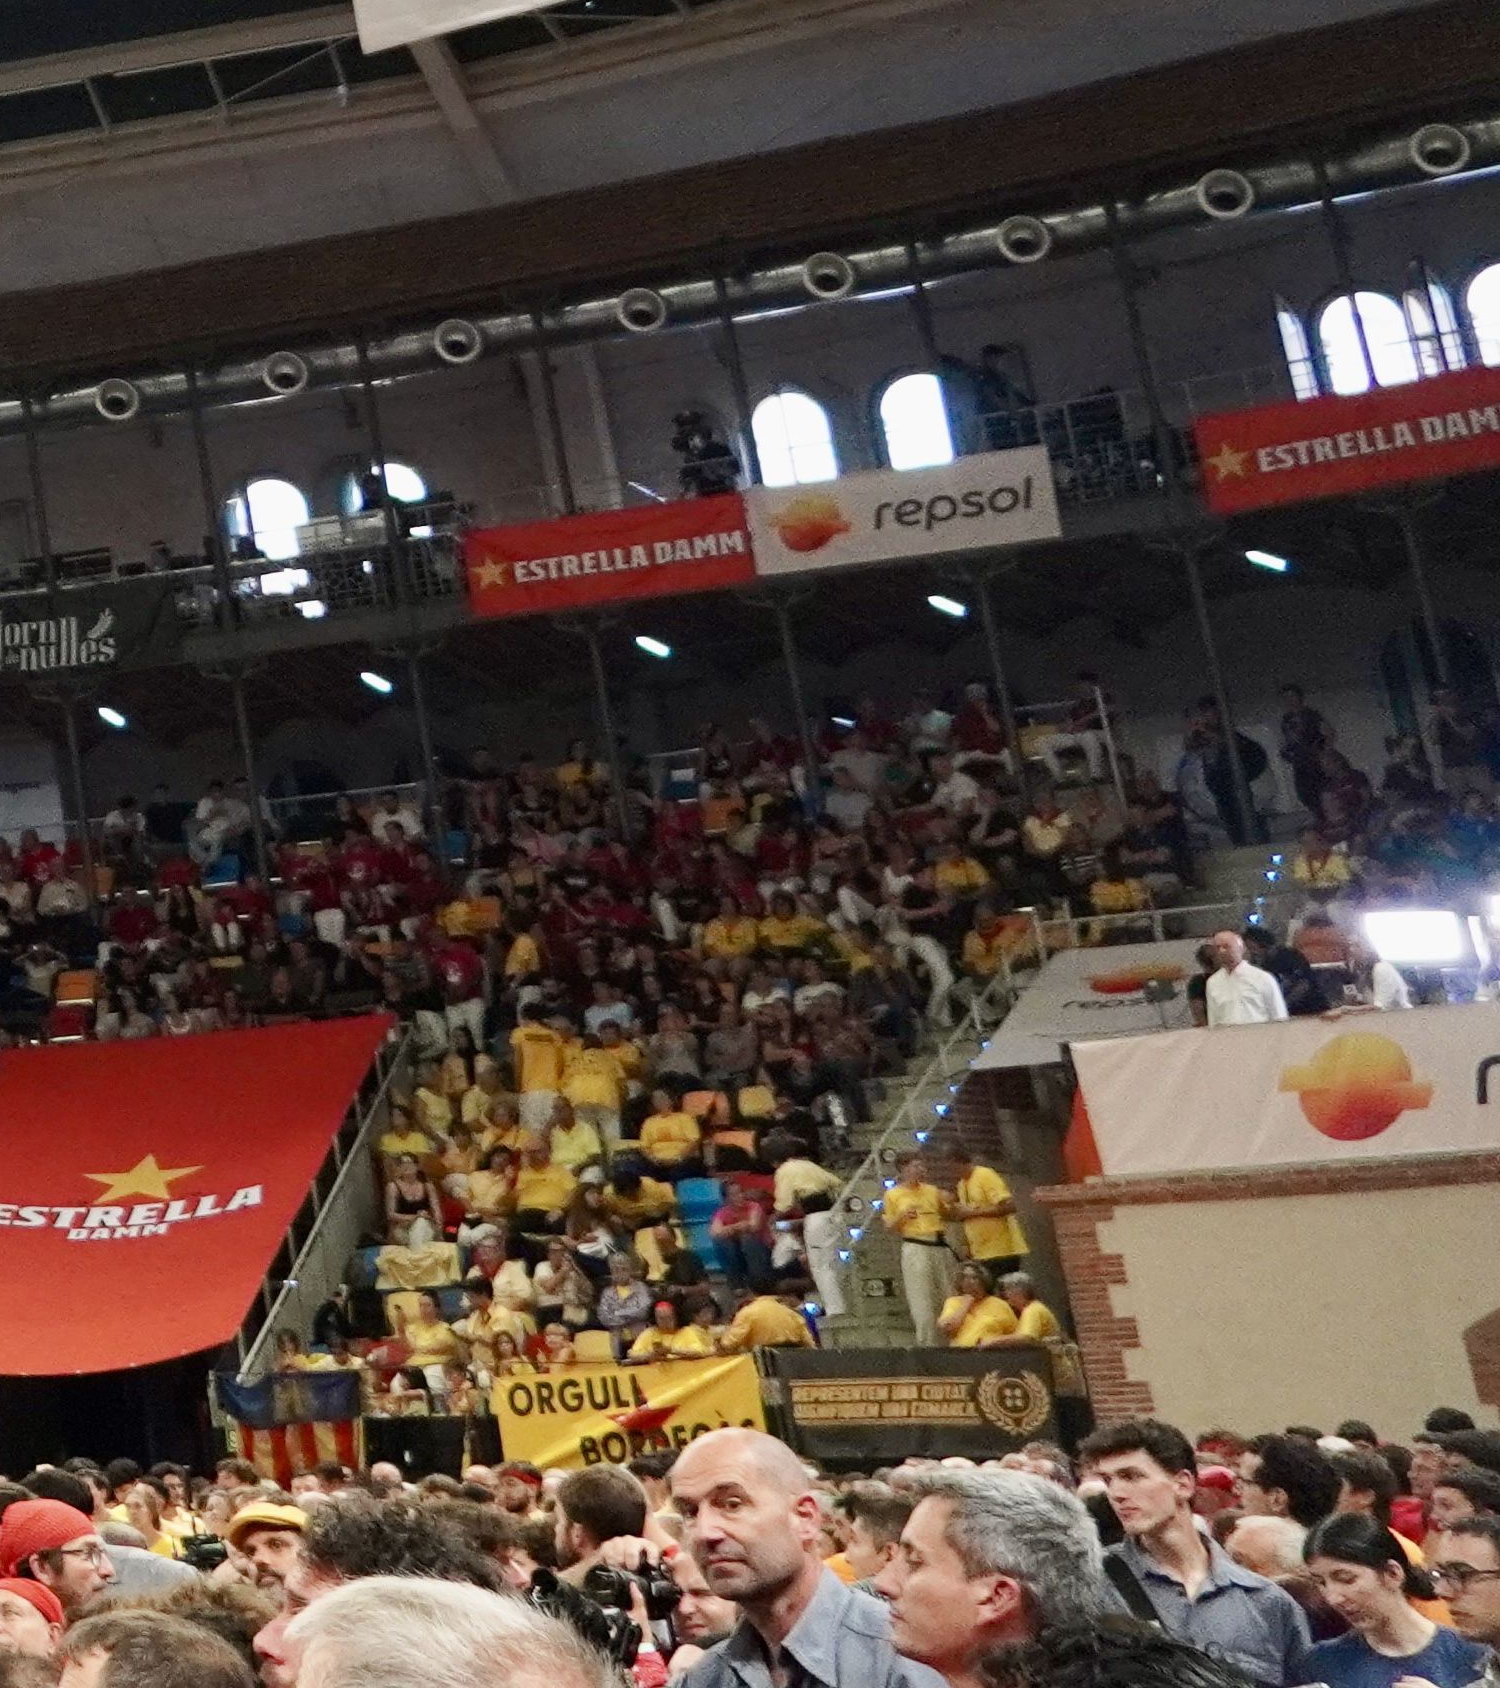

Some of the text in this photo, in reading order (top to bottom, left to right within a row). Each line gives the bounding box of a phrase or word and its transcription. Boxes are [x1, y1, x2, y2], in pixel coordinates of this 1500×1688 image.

[1257, 404, 1500, 474] ESTRELLA DAM
[873, 476, 1034, 532] repsol
[513, 528, 745, 584] ESTRELLA DAMM
[67, 1221, 170, 1242] DAMM
[508, 1373, 649, 1417] ORGULL
